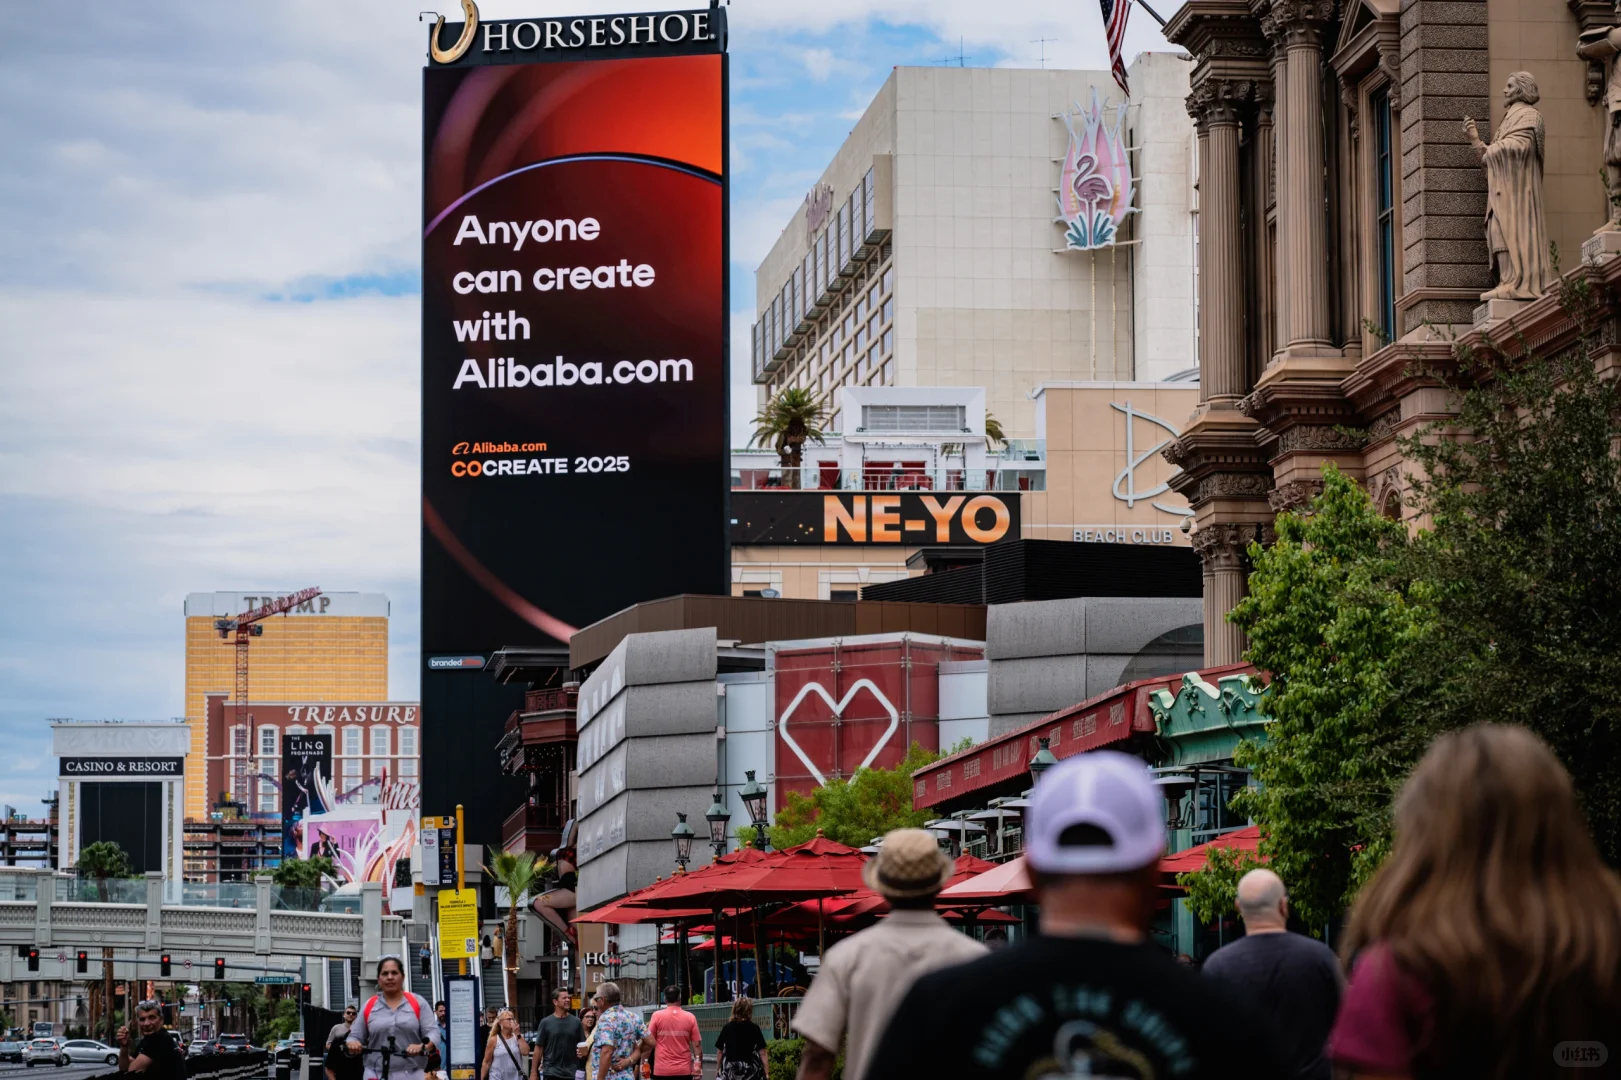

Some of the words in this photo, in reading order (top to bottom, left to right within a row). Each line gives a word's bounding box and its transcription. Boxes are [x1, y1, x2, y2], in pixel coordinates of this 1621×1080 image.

[482, 13, 709, 52] HORSESHOE
[453, 215, 600, 251] Anyone
[453, 269, 522, 295] can
[533, 259, 656, 291] create
[453, 310, 531, 342] with
[452, 355, 694, 389] Alibaba.com
[472, 441, 547, 454] Alibaba.com
[451, 457, 568, 477] COCREATE
[574, 455, 631, 473] 2025
[823, 495, 1011, 543] NE-YO
[1073, 529, 1126, 543] BEACH
[1132, 530, 1173, 544] CLUB
[244, 596, 331, 613] TRMP
[287, 706, 417, 724] TREASURE
[291, 741, 324, 750] LINQ
[66, 761, 114, 772] CASINO
[116, 761, 126, 772] &
[128, 761, 177, 772] RESORT
